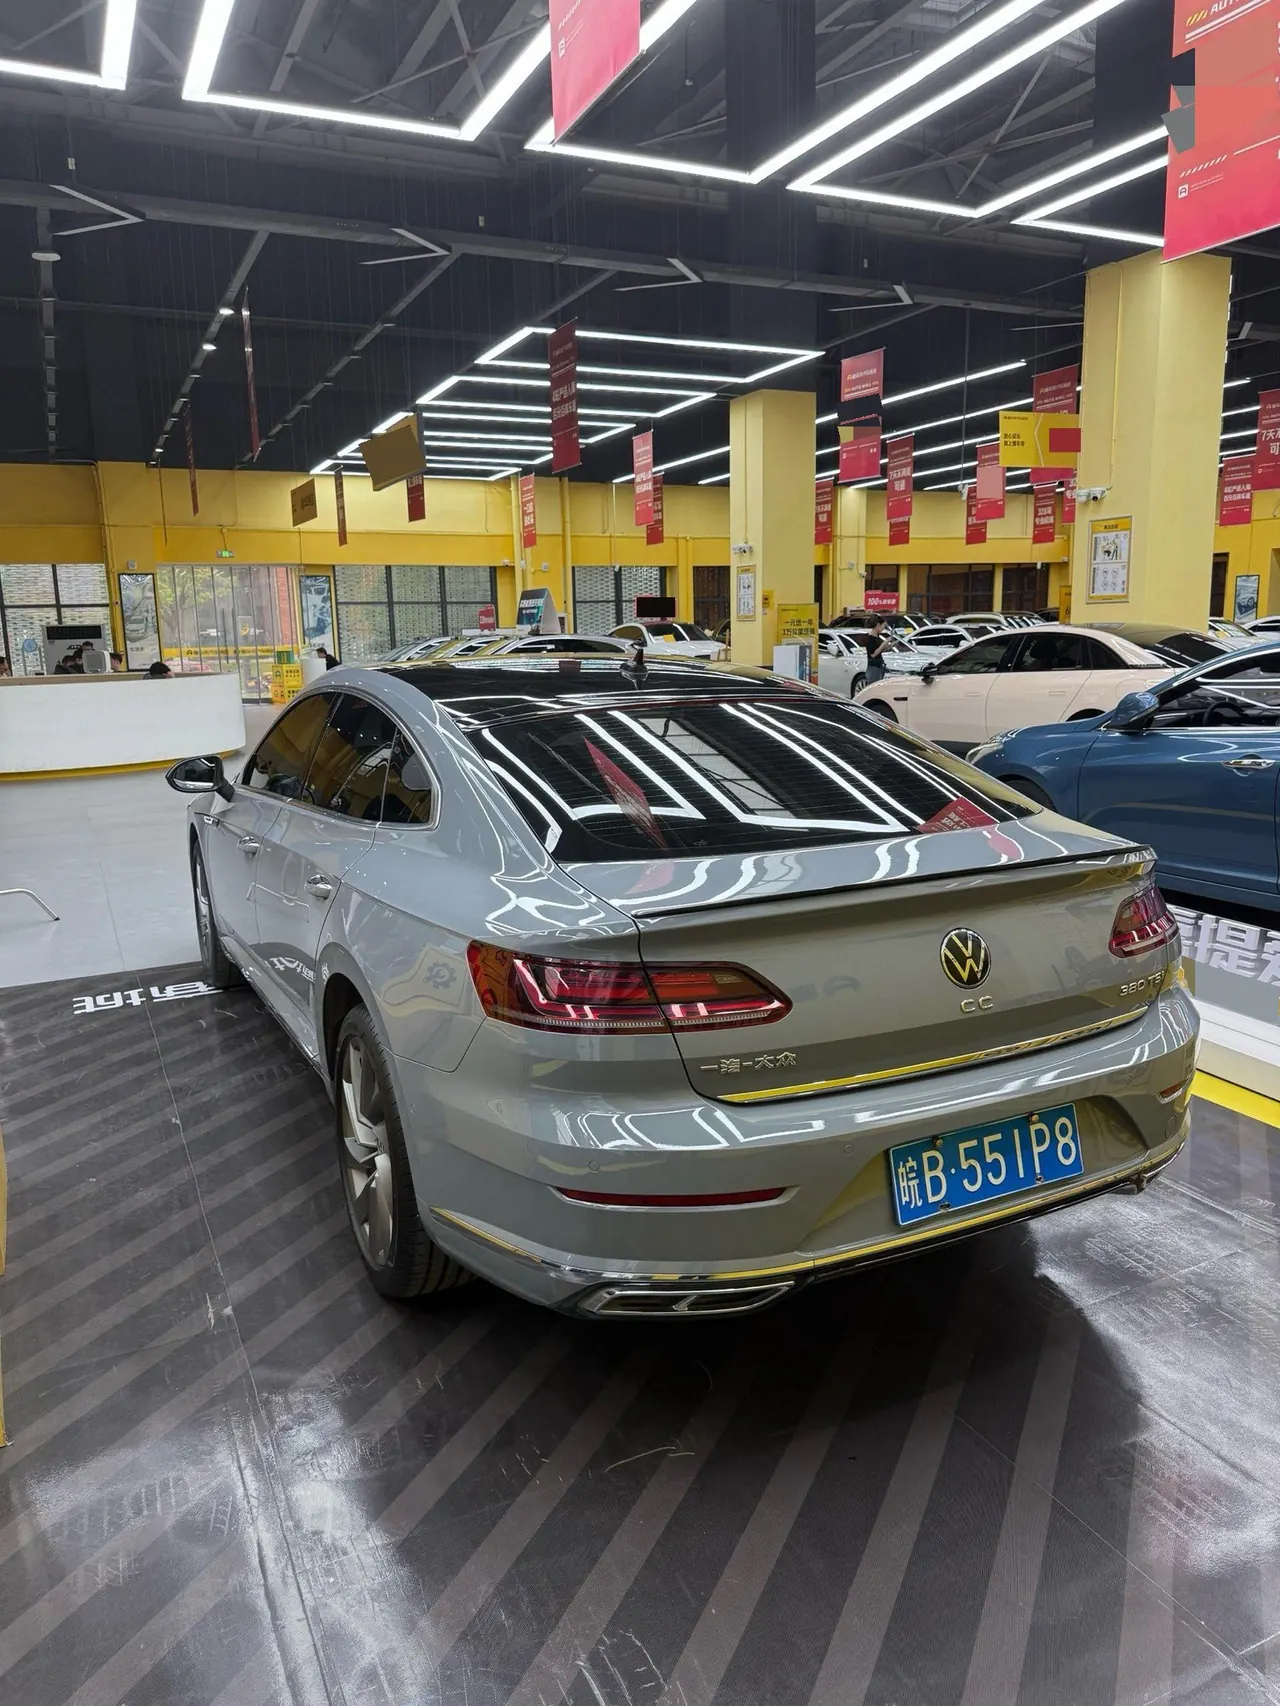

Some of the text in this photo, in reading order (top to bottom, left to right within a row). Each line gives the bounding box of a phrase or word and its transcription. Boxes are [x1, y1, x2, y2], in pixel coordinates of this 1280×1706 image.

[1119, 979, 1146, 997] 380
[960, 995, 994, 1014] CC
[700, 1051, 797, 1075] 一汽-大众
